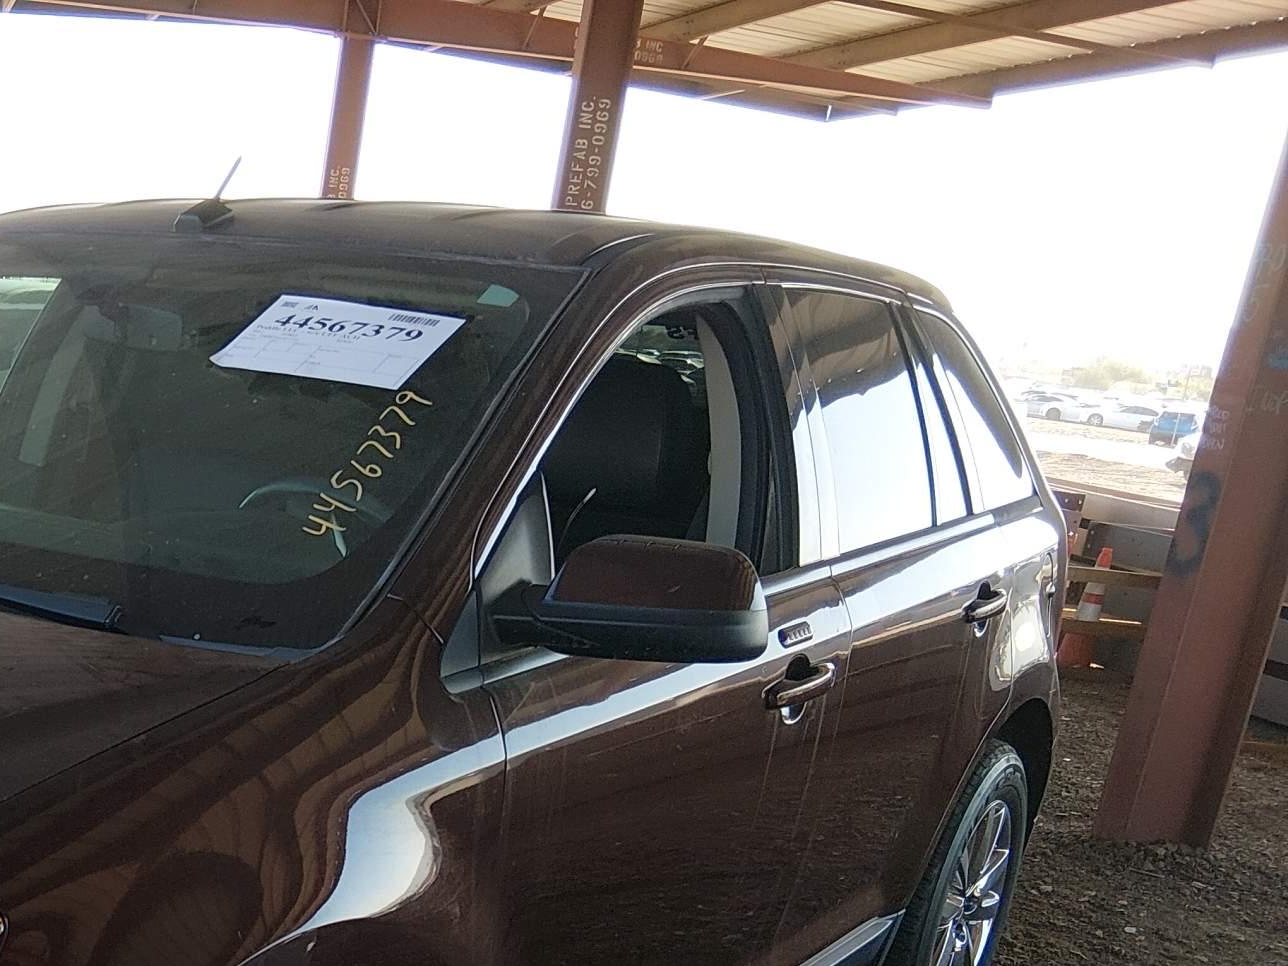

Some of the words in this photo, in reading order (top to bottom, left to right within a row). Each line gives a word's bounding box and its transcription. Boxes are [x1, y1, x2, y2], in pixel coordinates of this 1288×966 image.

[564, 138, 589, 206] PREFAB
[578, 96, 597, 129] INC.
[274, 313, 424, 343] 44567379
[301, 390, 433, 536] 44567379
